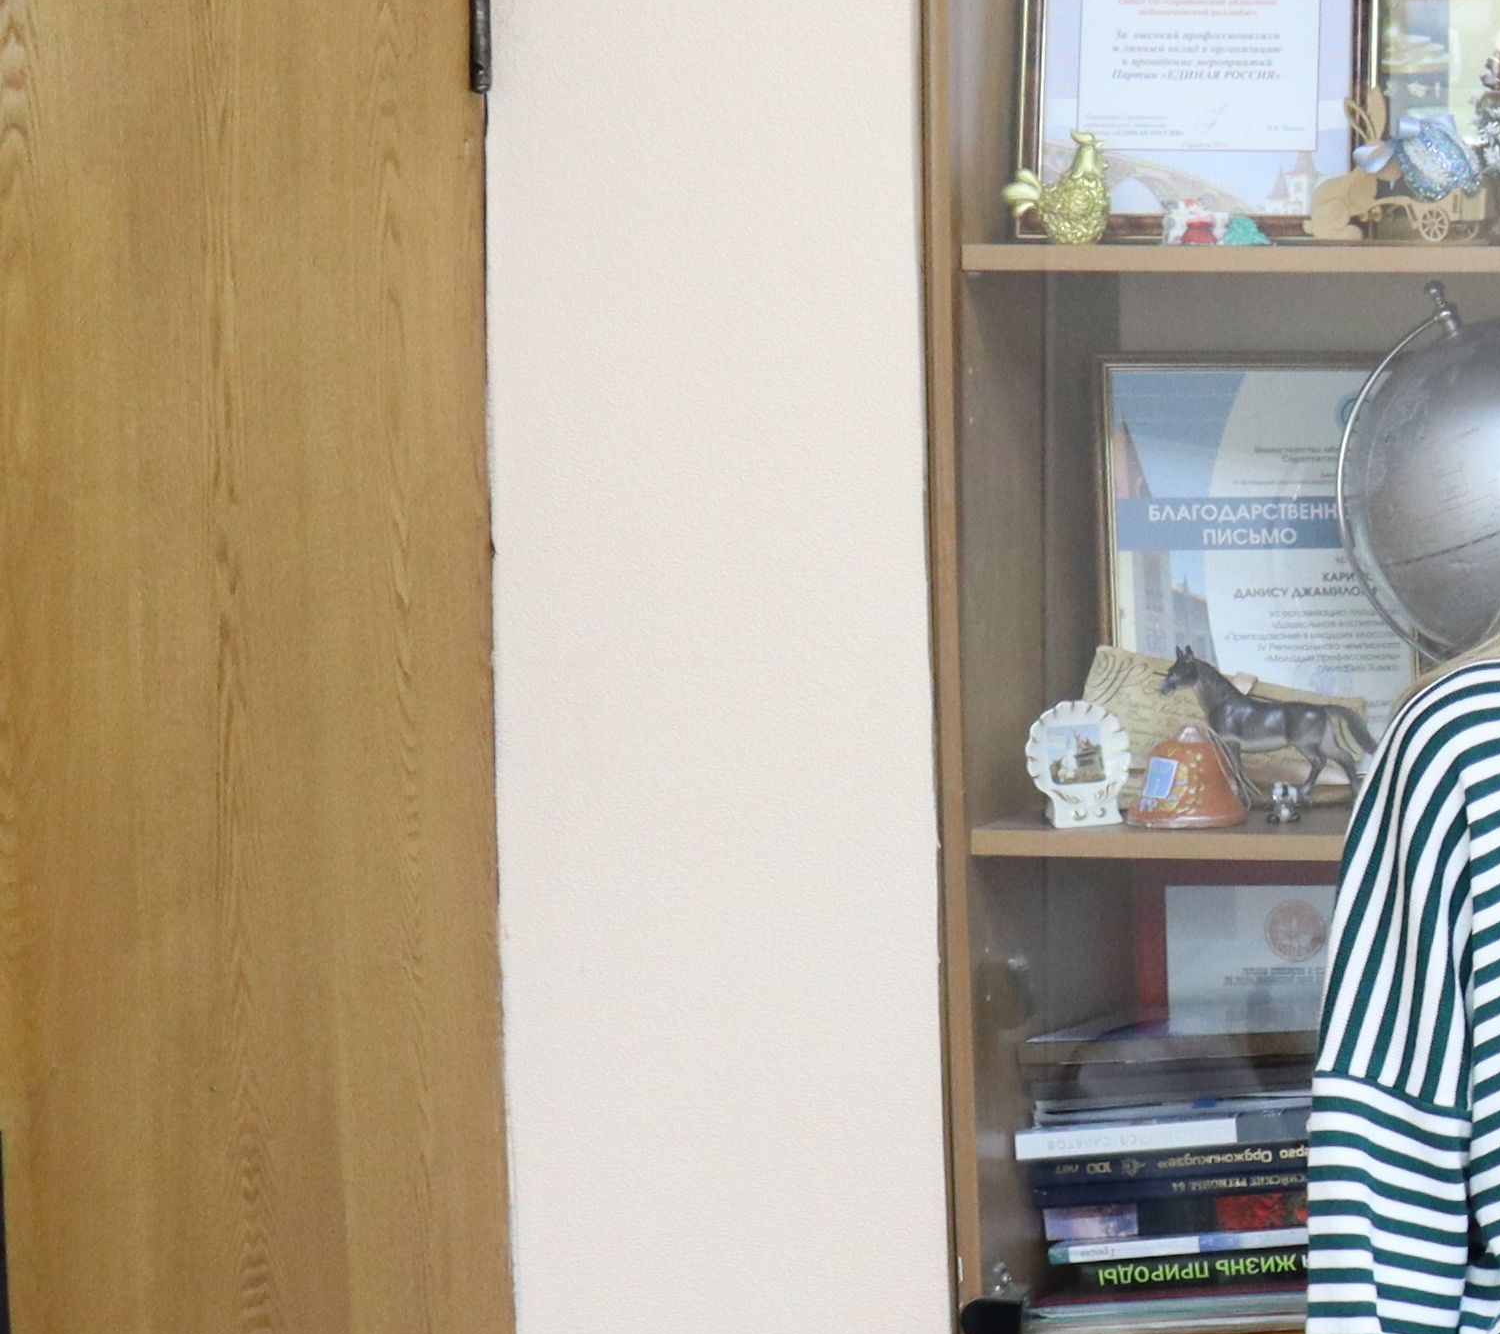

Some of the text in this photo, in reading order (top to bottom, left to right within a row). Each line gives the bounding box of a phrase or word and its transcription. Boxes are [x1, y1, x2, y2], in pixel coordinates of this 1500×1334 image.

[1111, 70, 1158, 81] Партии
[1223, 70, 1282, 81] РОССИЯ»
[1147, 503, 1338, 523] БЛАГОДАРСТВЕНН
[1203, 527, 1298, 545] ПИСЬМО
[1233, 587, 1364, 600] ДАНИСУ ДЖАМИЛО
[1086, 1161, 1112, 1174] 100
[1156, 1148, 1274, 1170] Орджоникидзе»
[1250, 1174, 1308, 1188] СИЙСКИЕ
[1215, 1253, 1297, 1276] ЖИЗНЬ
[1098, 1262, 1210, 1287] ПРИРОДЫ
